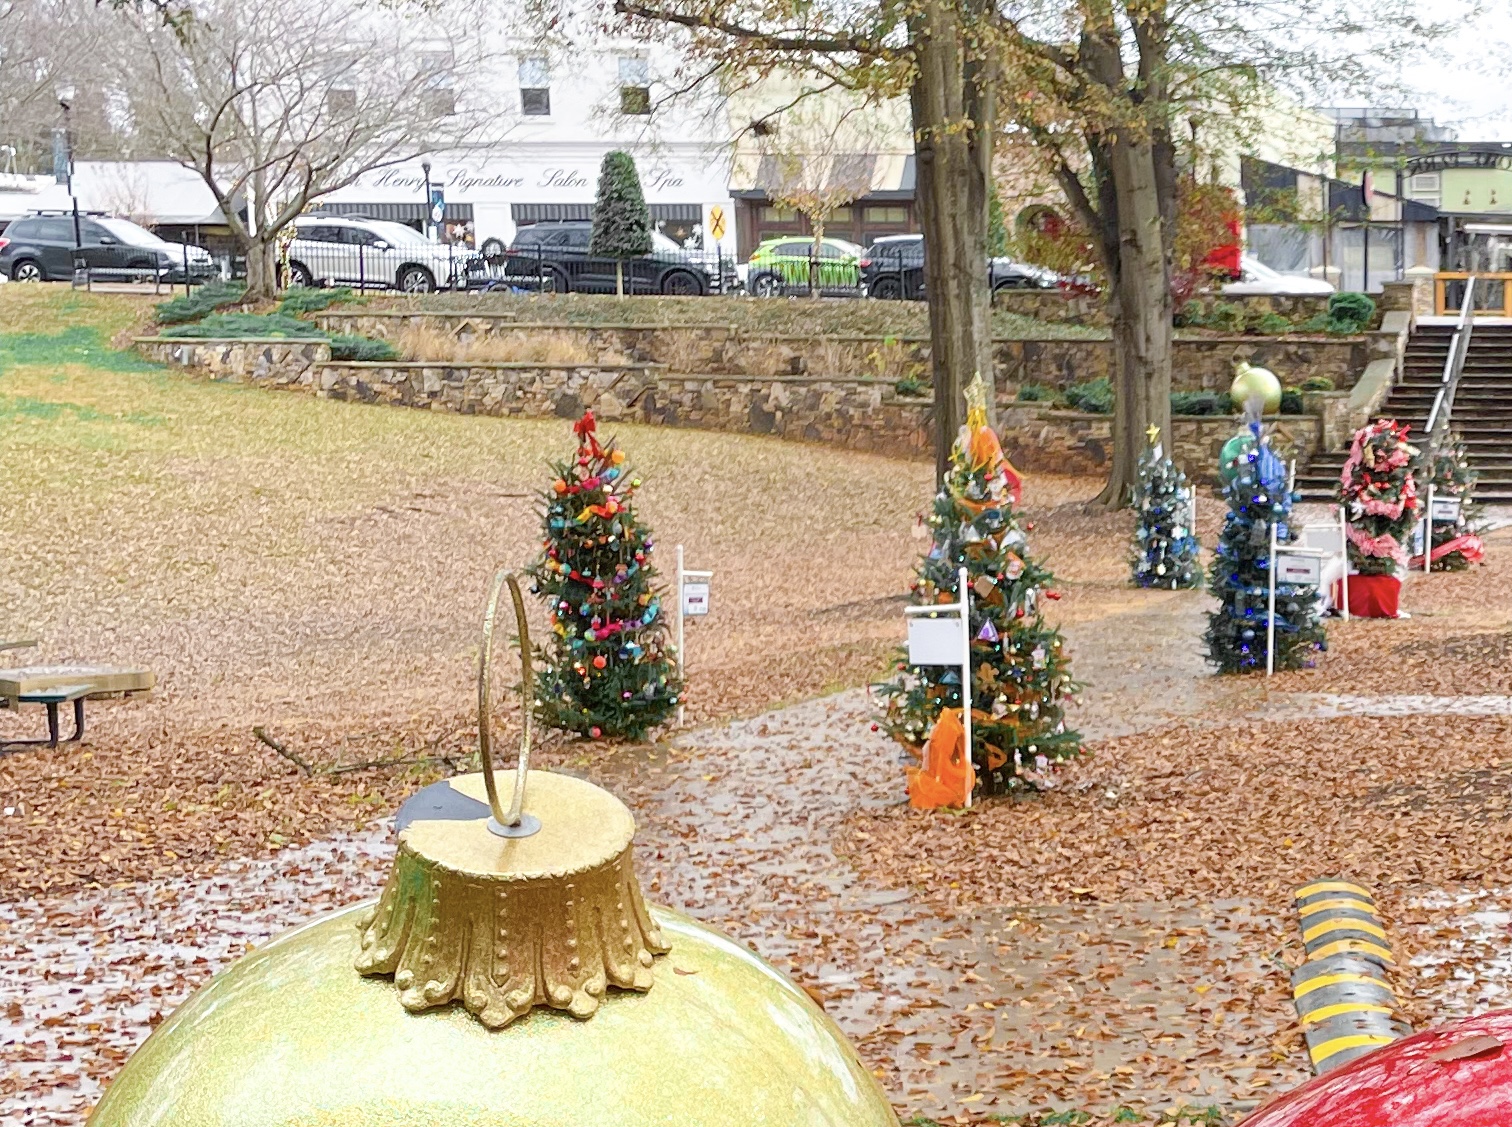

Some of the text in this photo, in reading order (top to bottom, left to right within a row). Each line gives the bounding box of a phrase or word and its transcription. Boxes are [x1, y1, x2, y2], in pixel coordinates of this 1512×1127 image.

[373, 169, 429, 193] Henry
[445, 169, 524, 193] Signature
[537, 168, 588, 187] Salon
[643, 168, 684, 192] Spa
